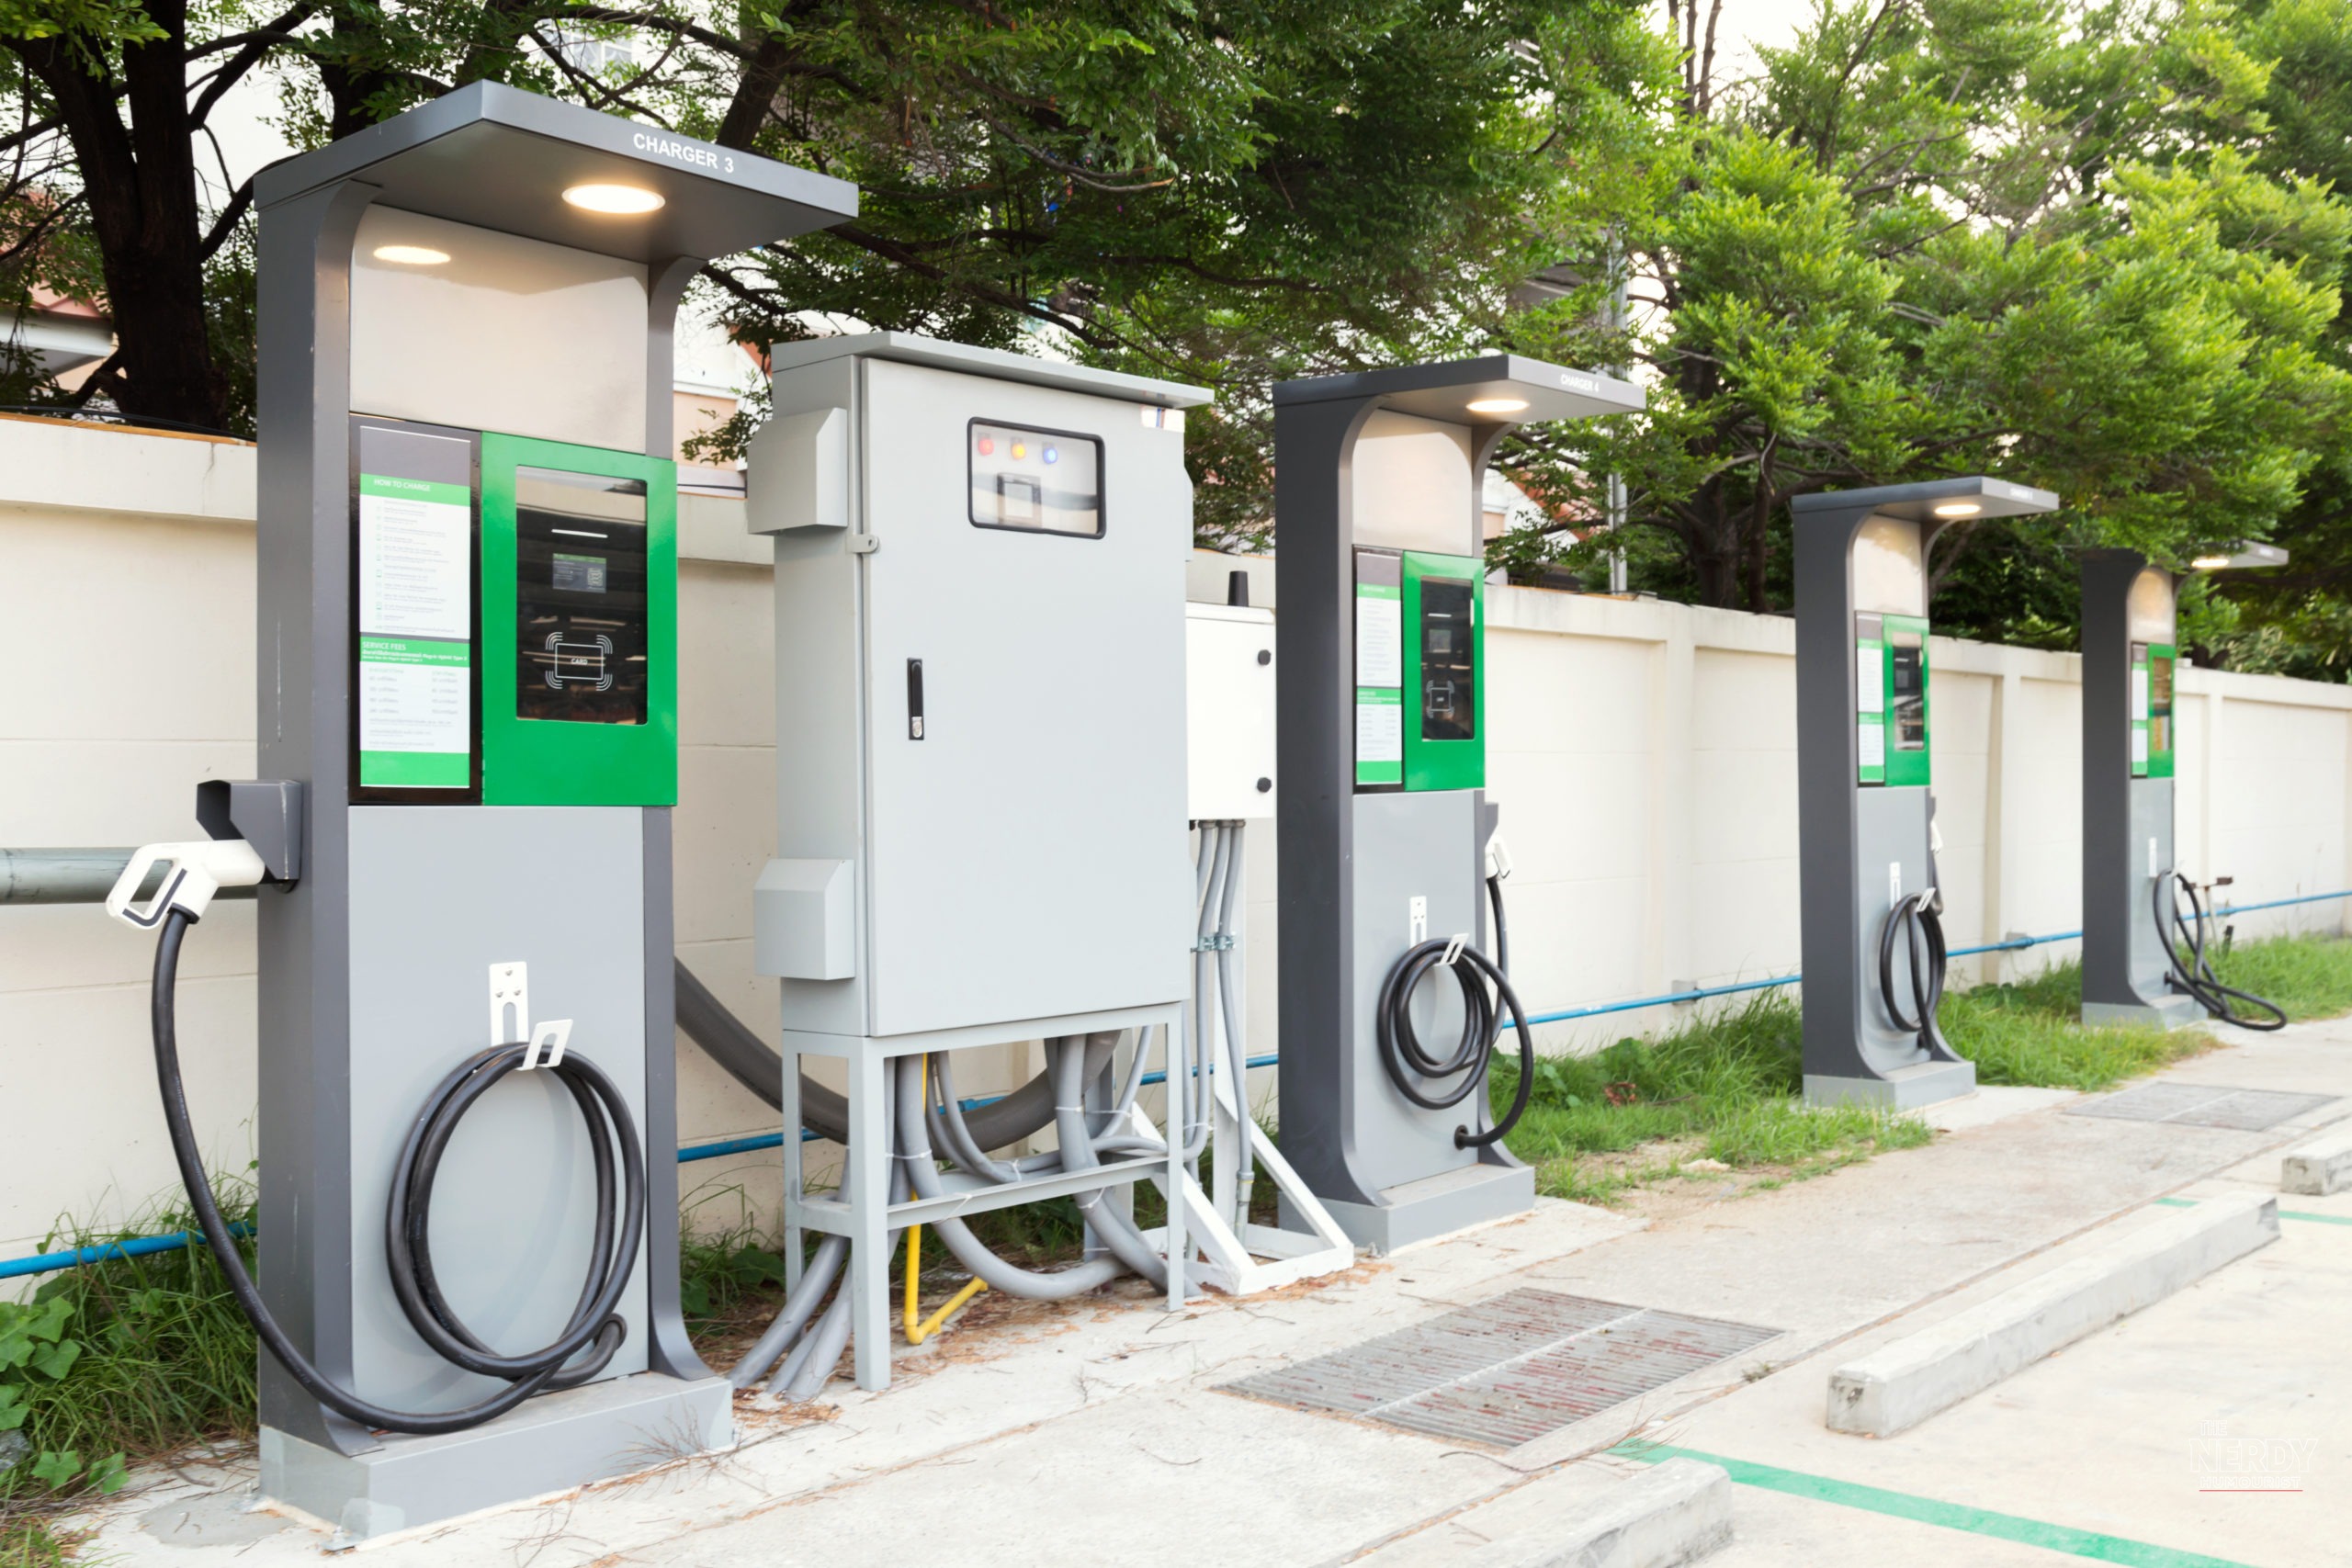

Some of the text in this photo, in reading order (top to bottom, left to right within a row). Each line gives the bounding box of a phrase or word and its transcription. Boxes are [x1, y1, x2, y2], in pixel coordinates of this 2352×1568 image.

[633, 133, 734, 174] CHARGER 3
[1561, 374, 1593, 391] CHARGER
[374, 479, 431, 492] HOW TO CHARGE
[362, 641, 406, 651] SERVICE FEES
[571, 658, 588, 666] CARD
